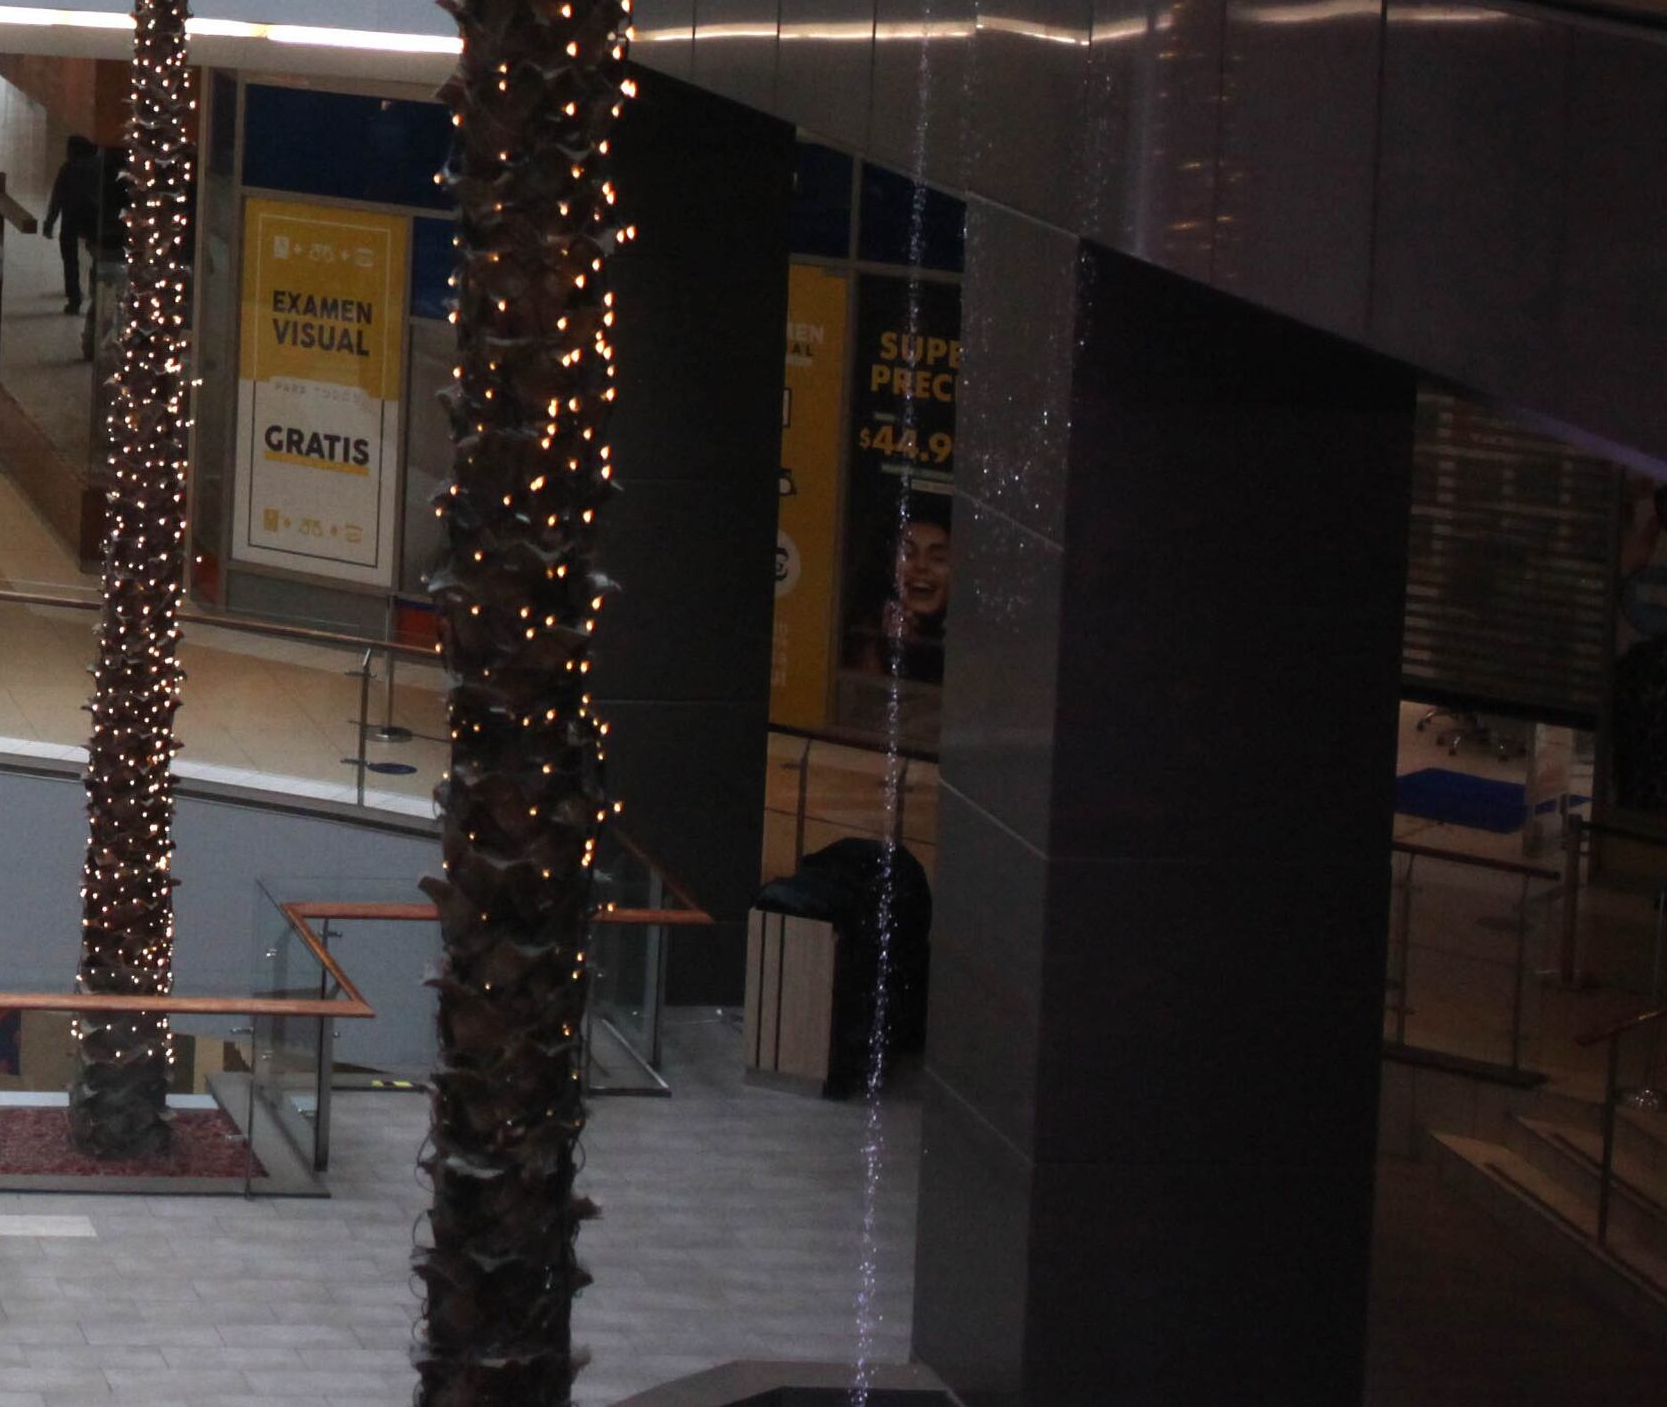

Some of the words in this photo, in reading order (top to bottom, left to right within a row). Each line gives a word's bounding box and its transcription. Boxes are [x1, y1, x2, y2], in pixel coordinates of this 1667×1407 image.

[273, 290, 372, 324] EXAMEN
[272, 319, 370, 357] VISUAL
[879, 330, 963, 370] SUPE
[870, 363, 955, 403] PREC
[264, 424, 370, 467] GRATIS
[858, 424, 954, 464] $44.9
